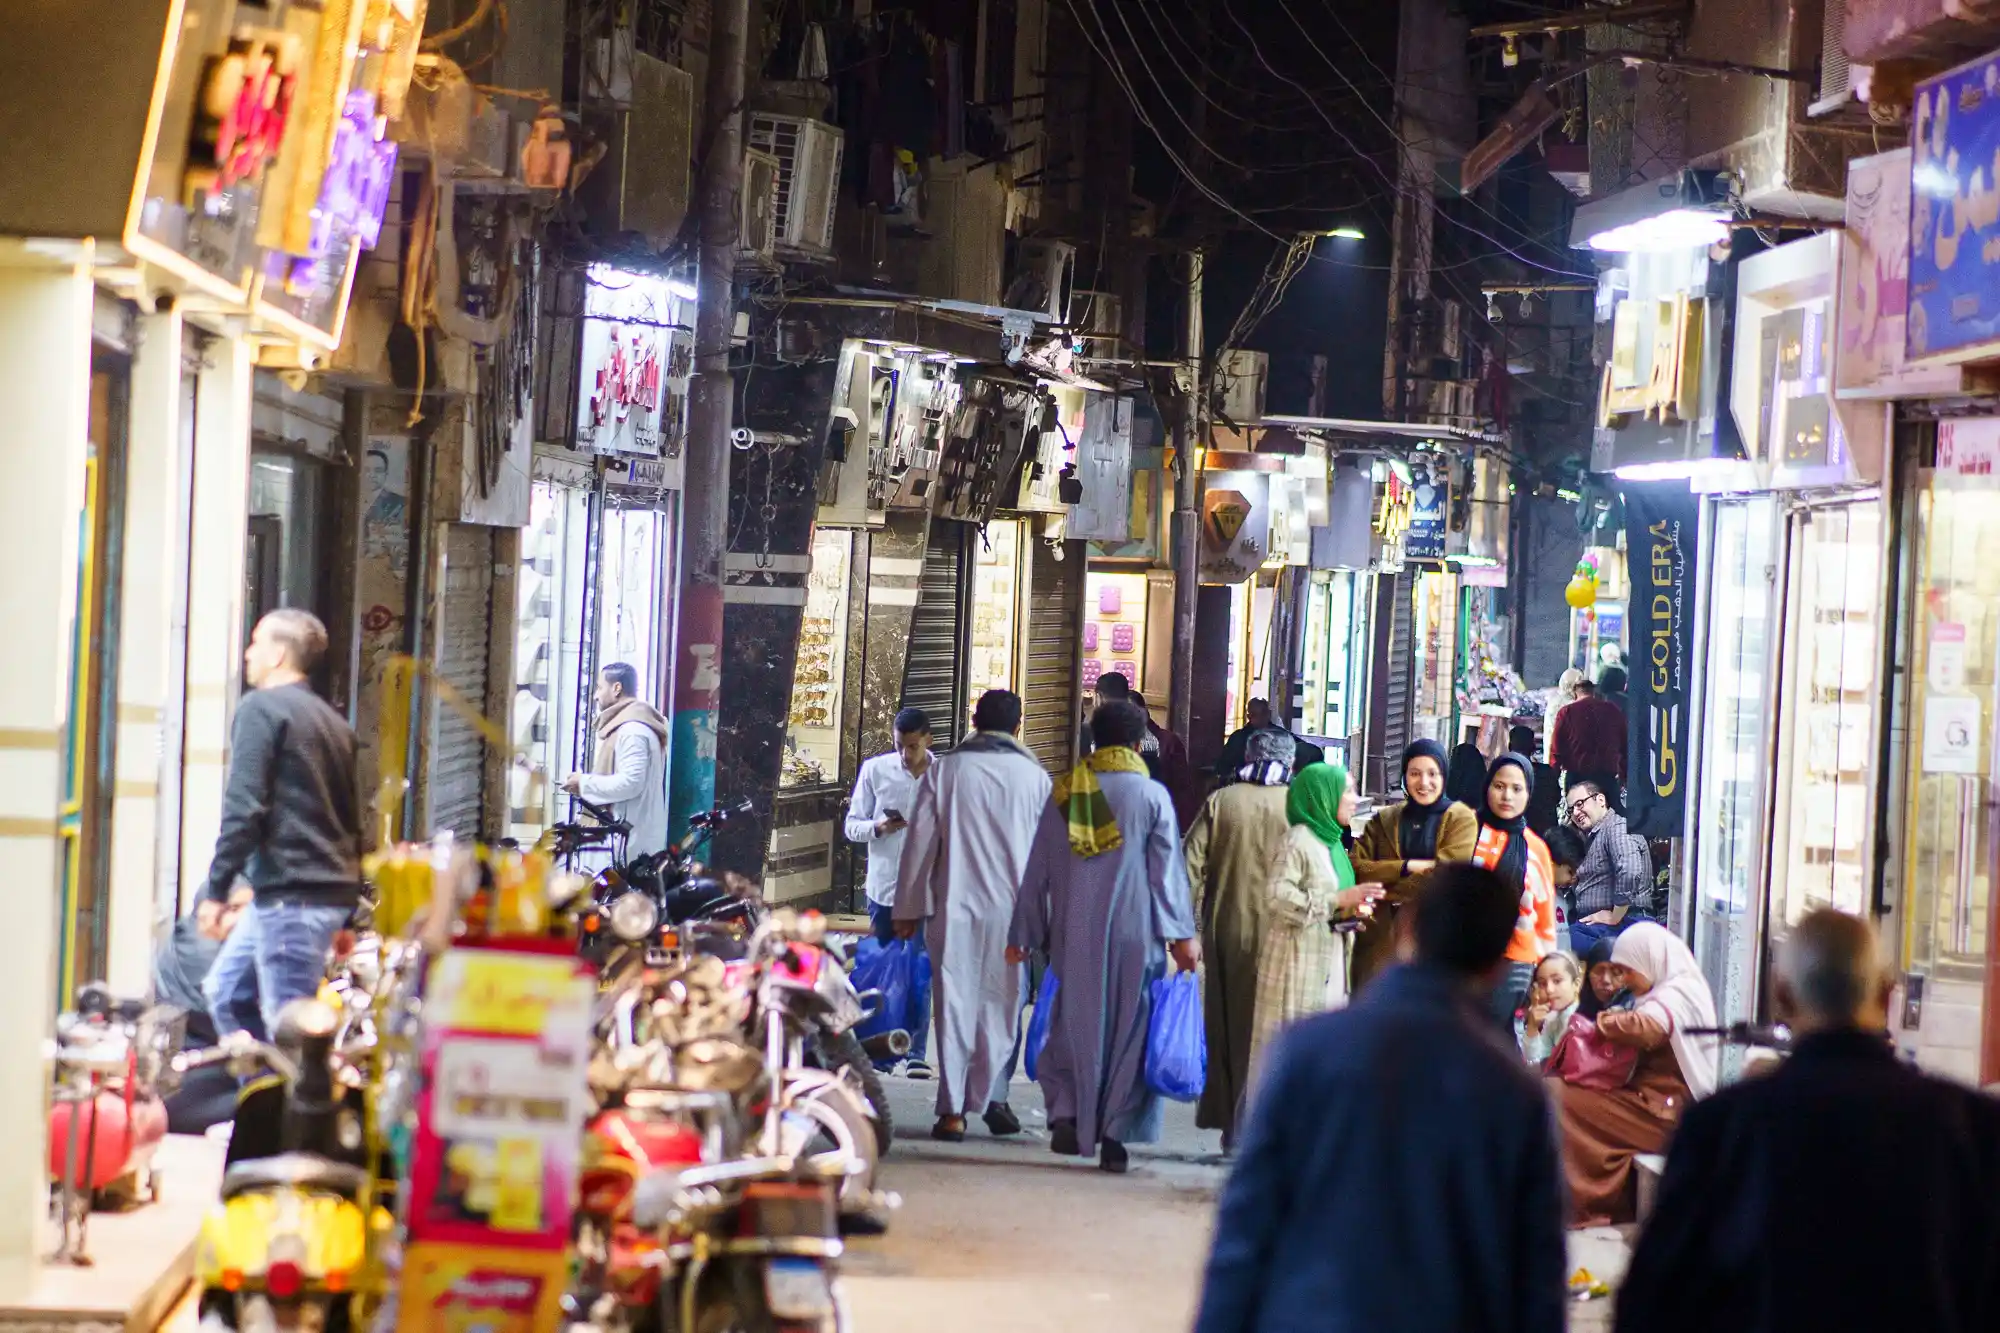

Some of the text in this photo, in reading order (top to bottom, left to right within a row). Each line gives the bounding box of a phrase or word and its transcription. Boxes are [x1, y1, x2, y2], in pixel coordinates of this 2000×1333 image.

[1649, 519, 1673, 693] GOLD ERA
[1673, 656, 1681, 691] مصر
